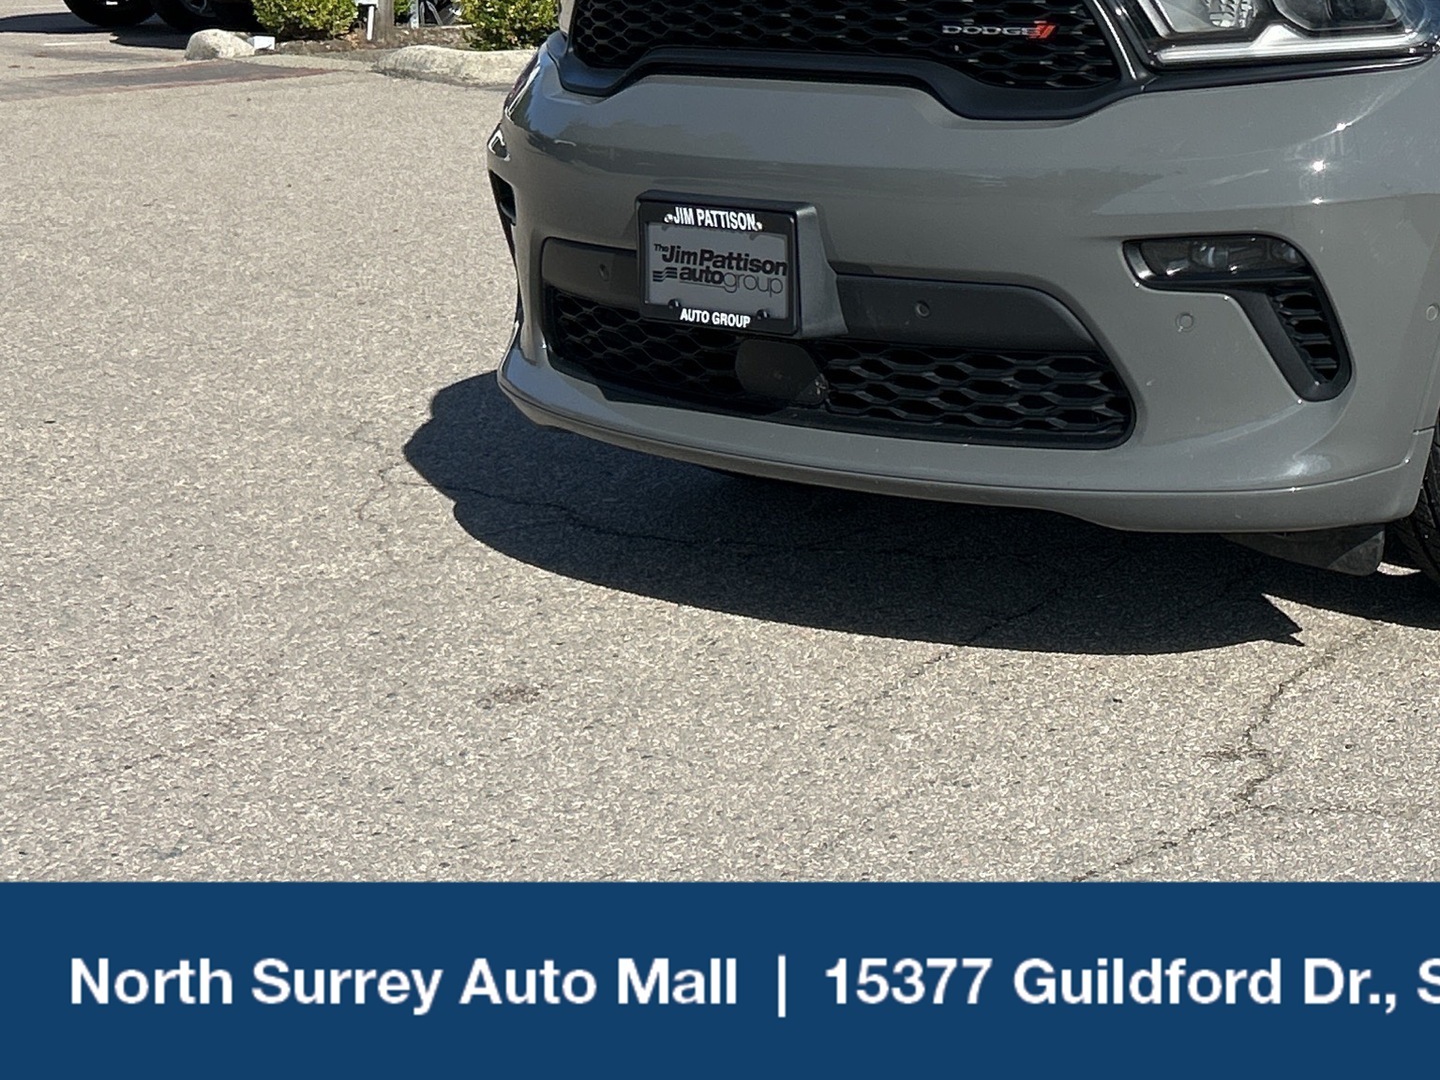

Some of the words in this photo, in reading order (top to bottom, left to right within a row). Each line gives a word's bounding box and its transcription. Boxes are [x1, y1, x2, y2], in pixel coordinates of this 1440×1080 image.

[942, 25, 1042, 36] DODGE
[673, 206, 695, 226] JIM
[696, 208, 758, 231] PATTISON
[653, 243, 669, 253] The
[680, 308, 710, 324] AUTO
[712, 311, 751, 328] GROUP
